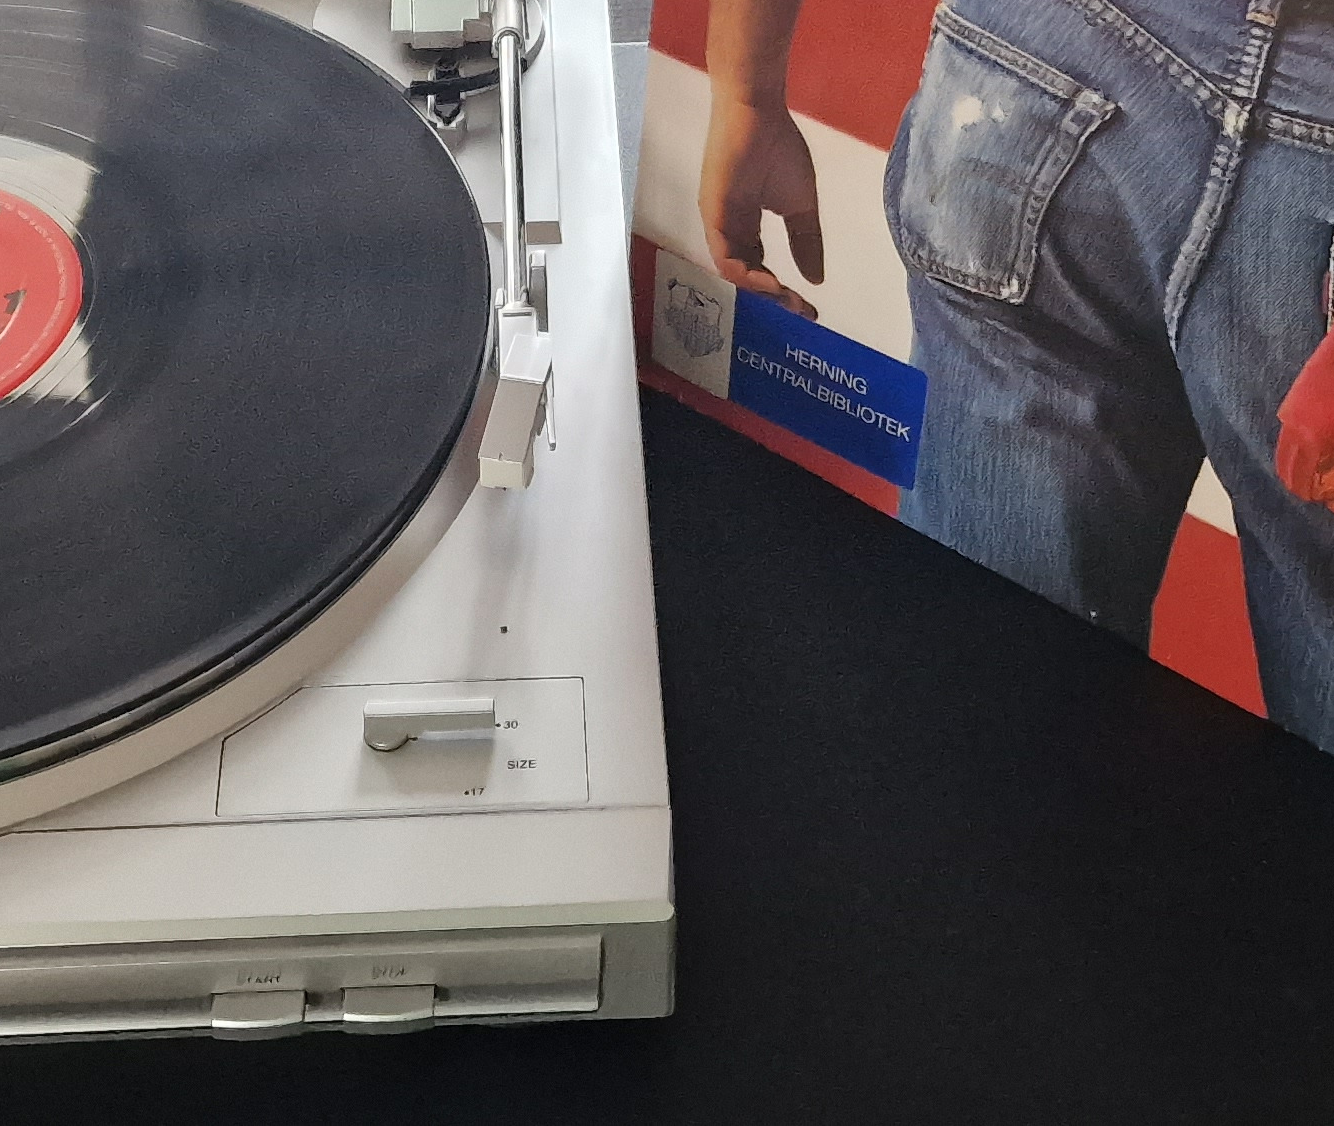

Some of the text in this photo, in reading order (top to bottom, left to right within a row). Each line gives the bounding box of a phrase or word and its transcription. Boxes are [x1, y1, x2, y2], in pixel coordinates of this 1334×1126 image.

[785, 342, 869, 396] HERNING
[736, 345, 911, 443] CENTRALBIBLIOTEK
[503, 720, 519, 730] 30
[507, 759, 537, 770] SIZE
[471, 787, 486, 796] 17
